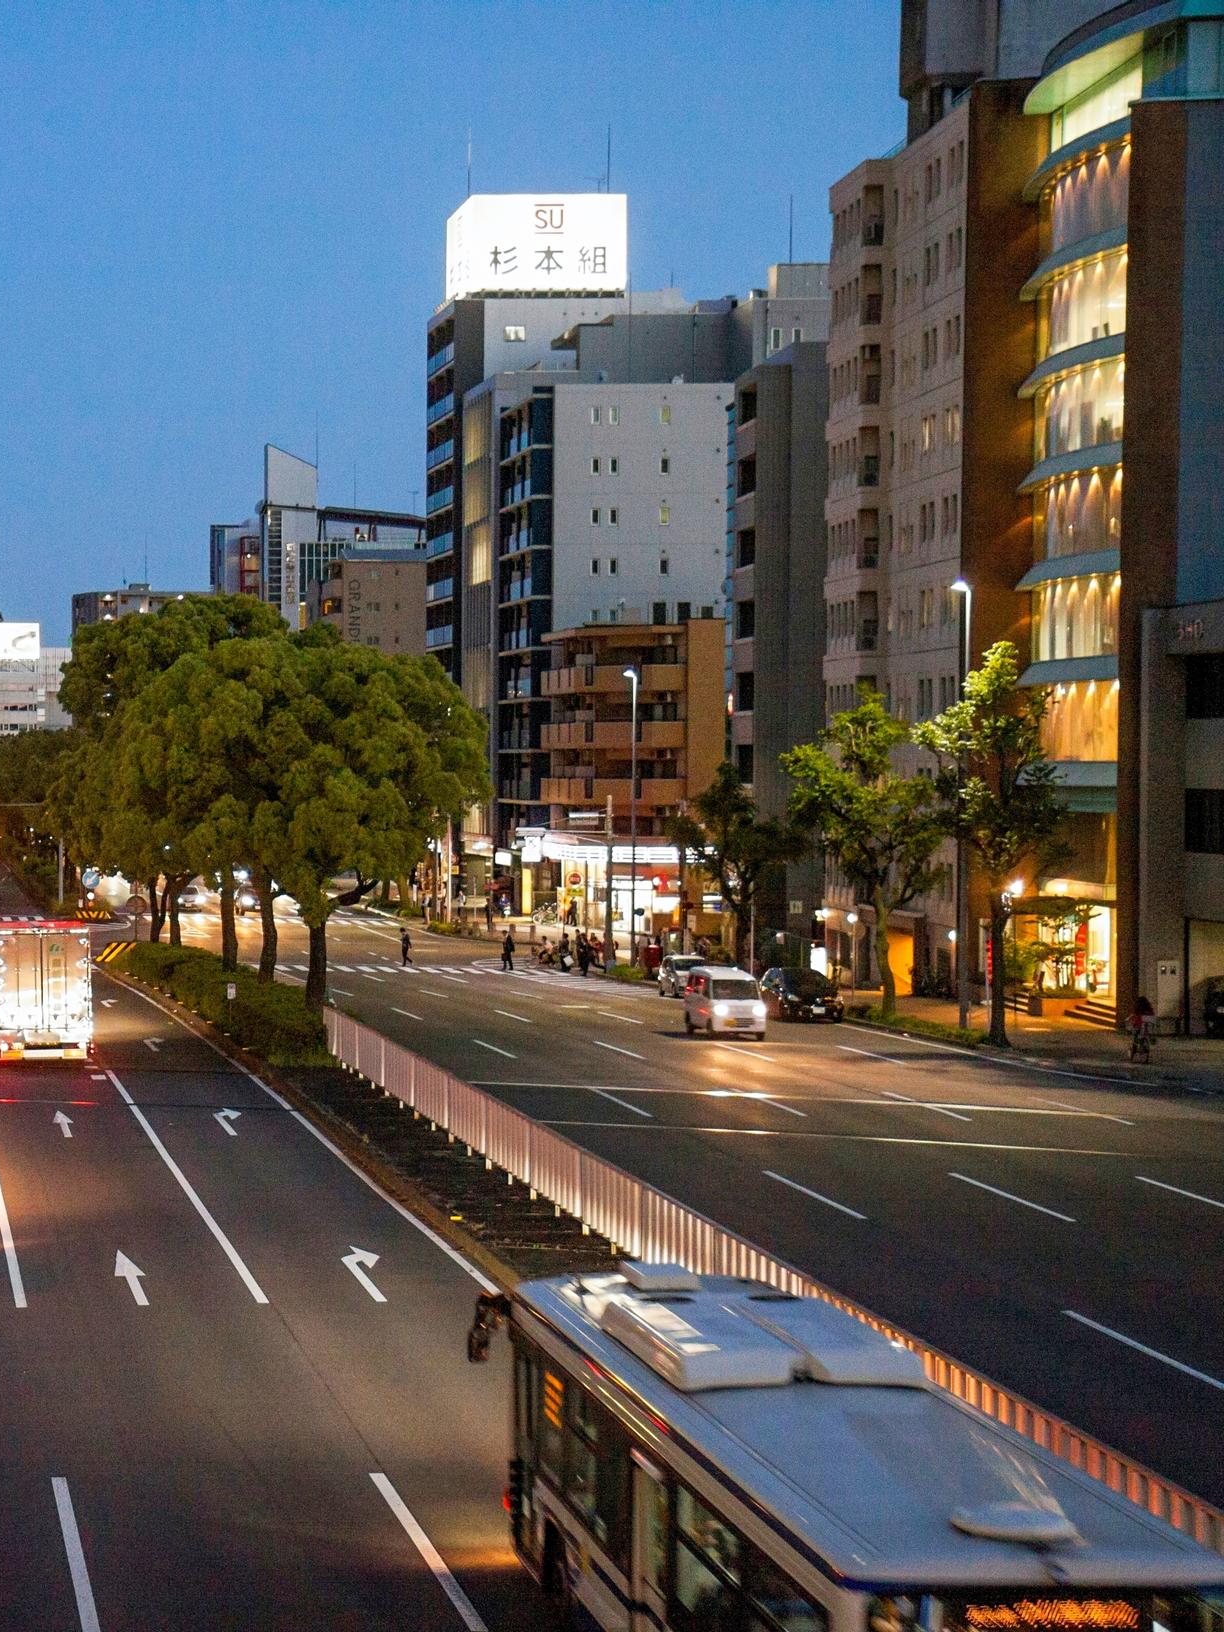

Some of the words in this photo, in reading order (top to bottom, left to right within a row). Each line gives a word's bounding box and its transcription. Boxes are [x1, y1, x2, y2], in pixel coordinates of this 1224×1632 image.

[535, 209, 564, 229] SU
[489, 245, 607, 275] 杉本組
